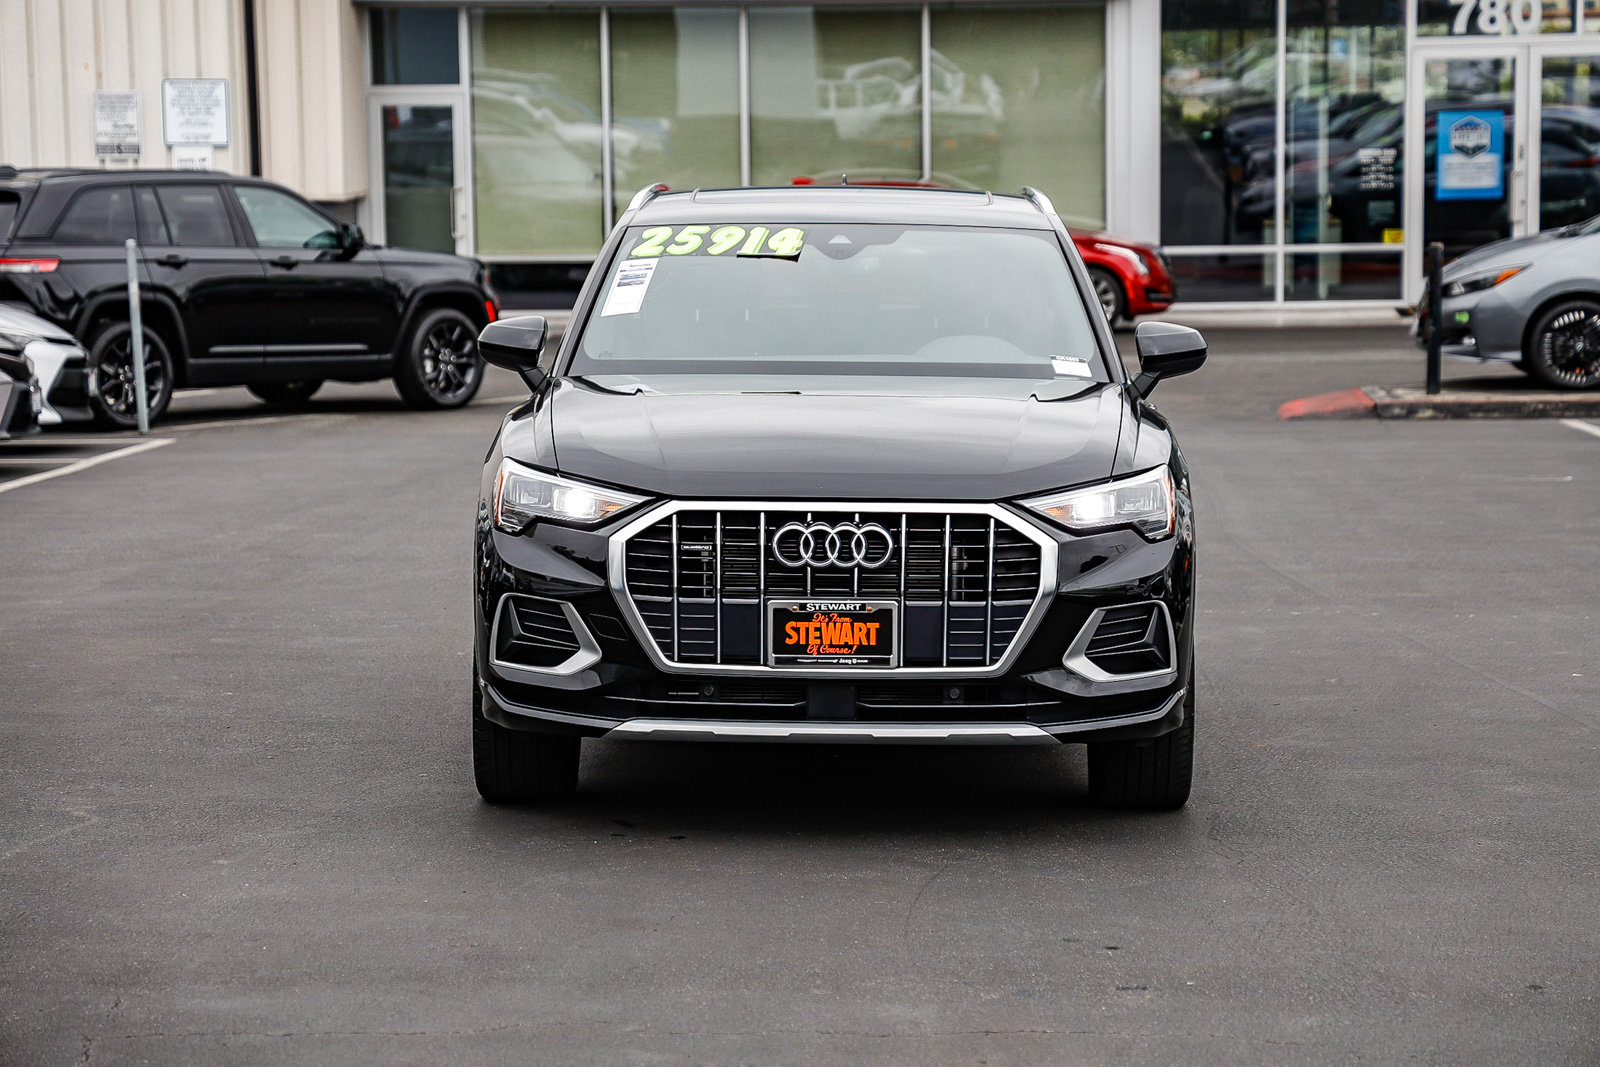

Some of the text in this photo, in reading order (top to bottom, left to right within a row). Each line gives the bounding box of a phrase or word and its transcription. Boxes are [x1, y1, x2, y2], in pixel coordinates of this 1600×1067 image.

[1449, 0, 1543, 35] 780
[630, 225, 805, 257] 25914
[806, 603, 861, 611] STEWART
[812, 612, 852, 623] It's From
[785, 621, 880, 645] STEWART
[807, 644, 818, 655] Of
